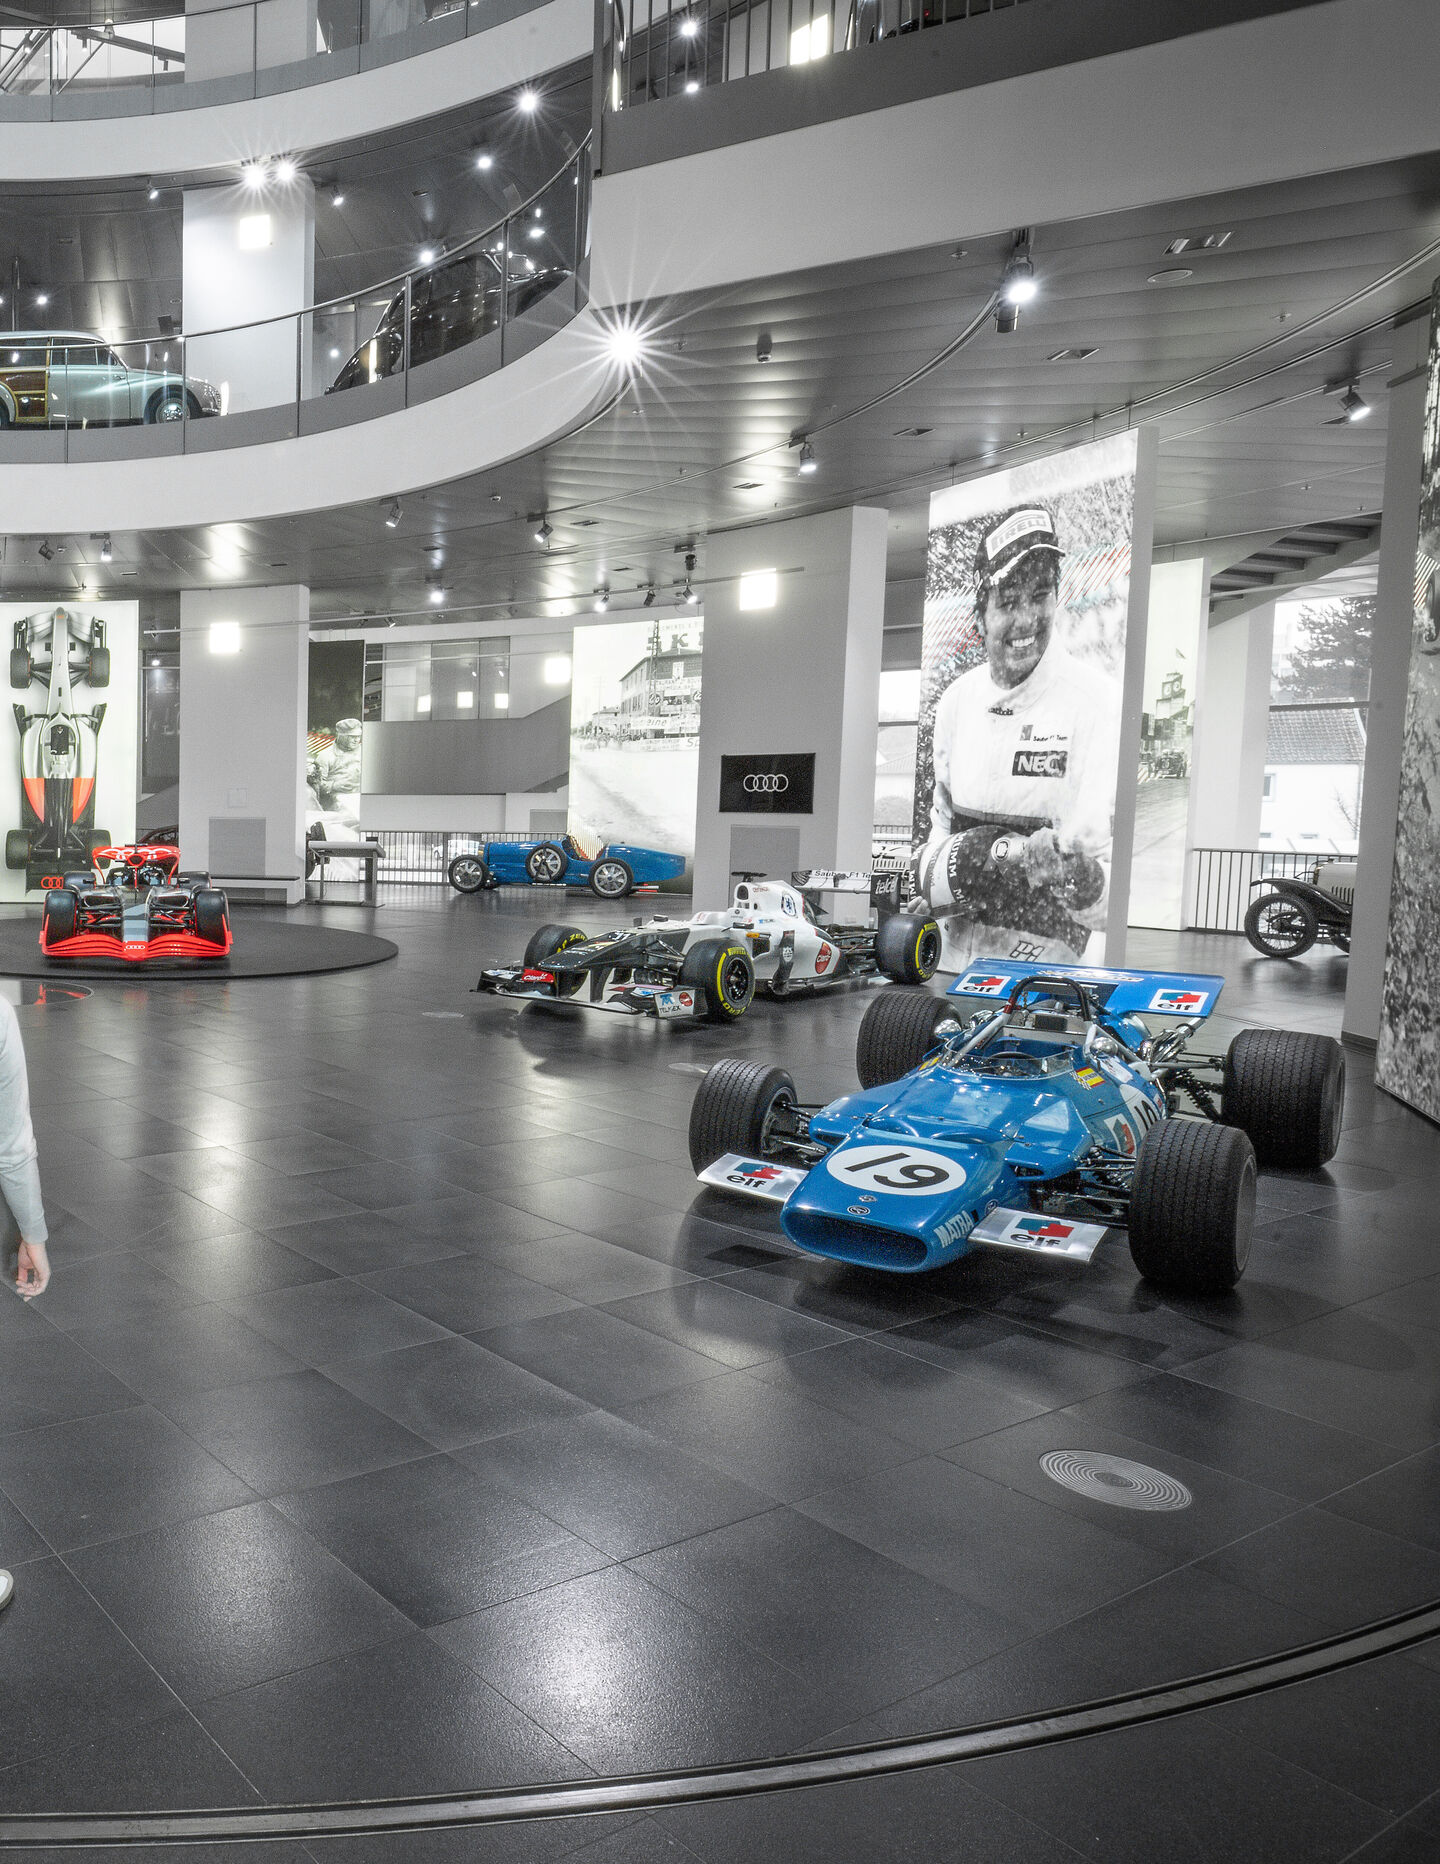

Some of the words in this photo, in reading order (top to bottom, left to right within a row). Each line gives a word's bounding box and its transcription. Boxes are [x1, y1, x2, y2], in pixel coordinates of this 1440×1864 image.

[991, 511, 1048, 552] PIRELLI
[1017, 754, 1063, 775] NEC
[963, 984, 994, 994] elf
[1156, 1001, 1194, 1012] elf
[844, 1152, 950, 1189] 19
[726, 1174, 766, 1188] elf
[933, 1209, 974, 1249] MATRA
[1009, 1230, 1062, 1248] elf
